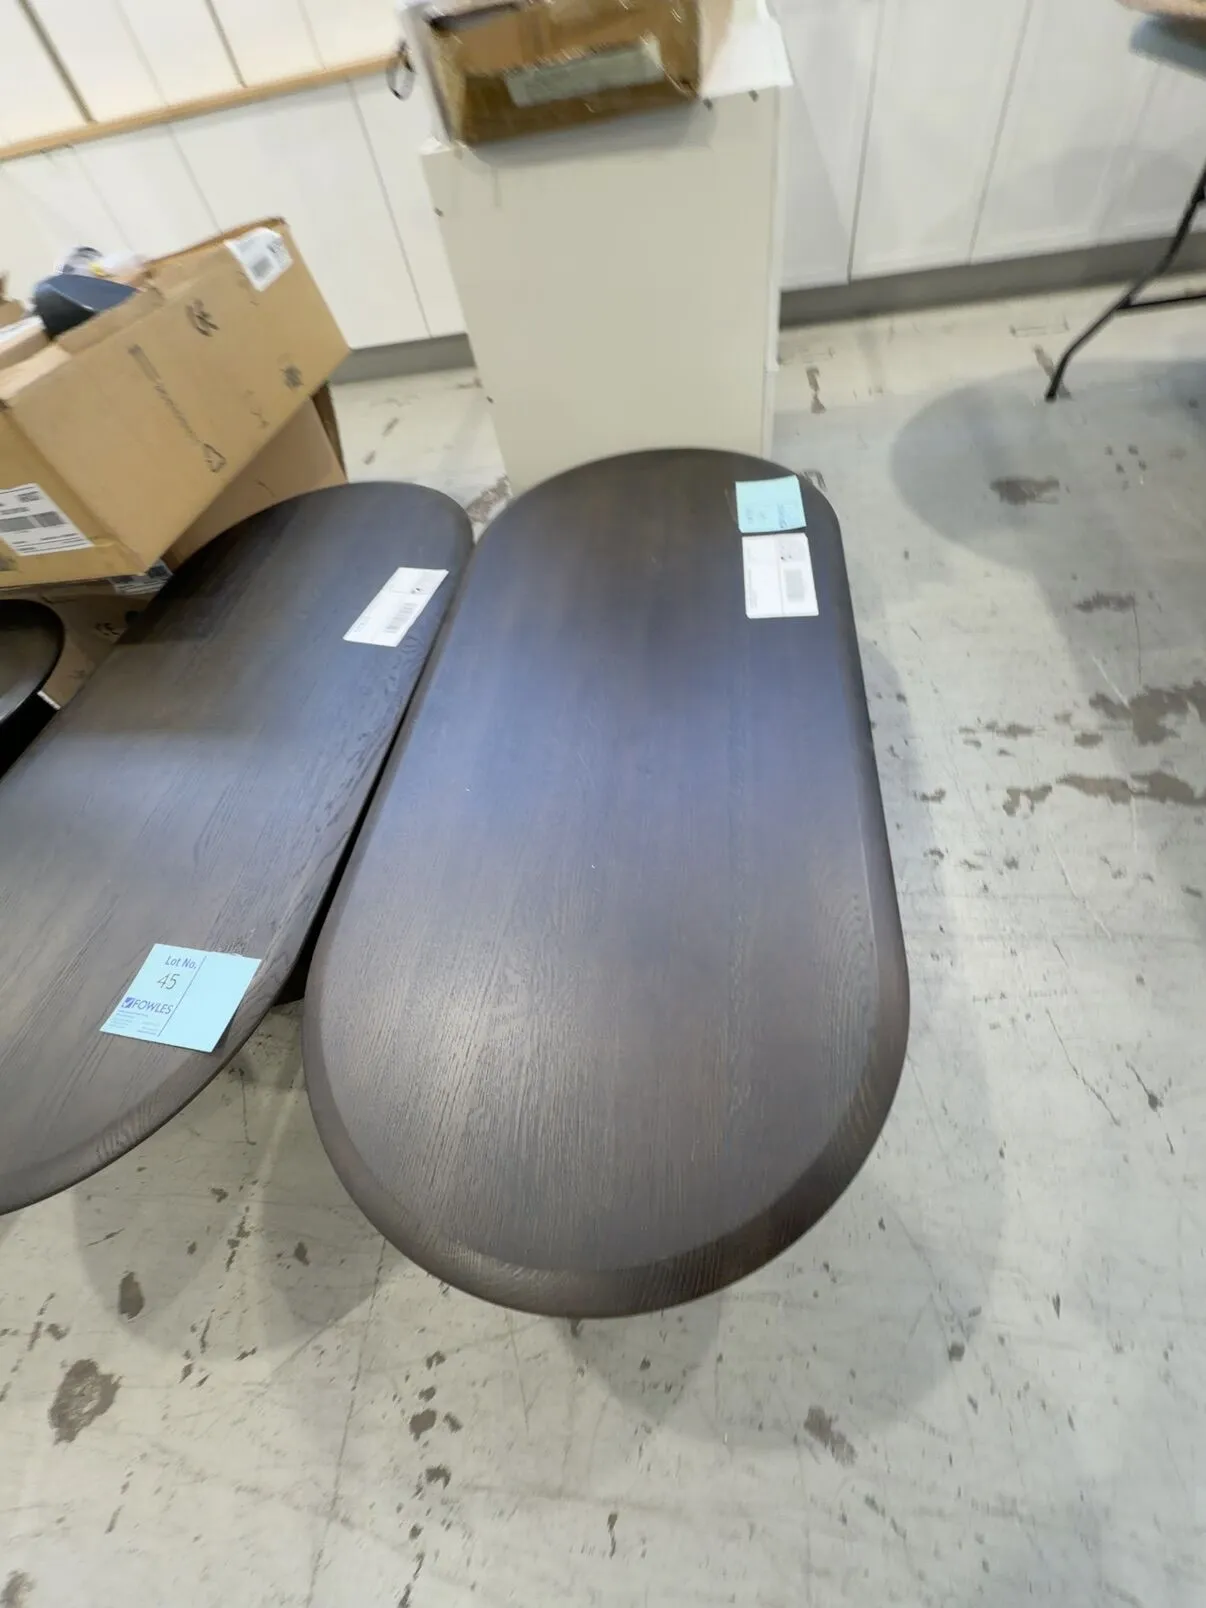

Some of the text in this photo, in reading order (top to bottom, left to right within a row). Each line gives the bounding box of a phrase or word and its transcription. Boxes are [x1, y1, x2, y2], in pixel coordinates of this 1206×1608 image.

[165, 956, 197, 969] Lot No.
[157, 973, 181, 990] 45
[131, 999, 173, 1014] FOWLES
